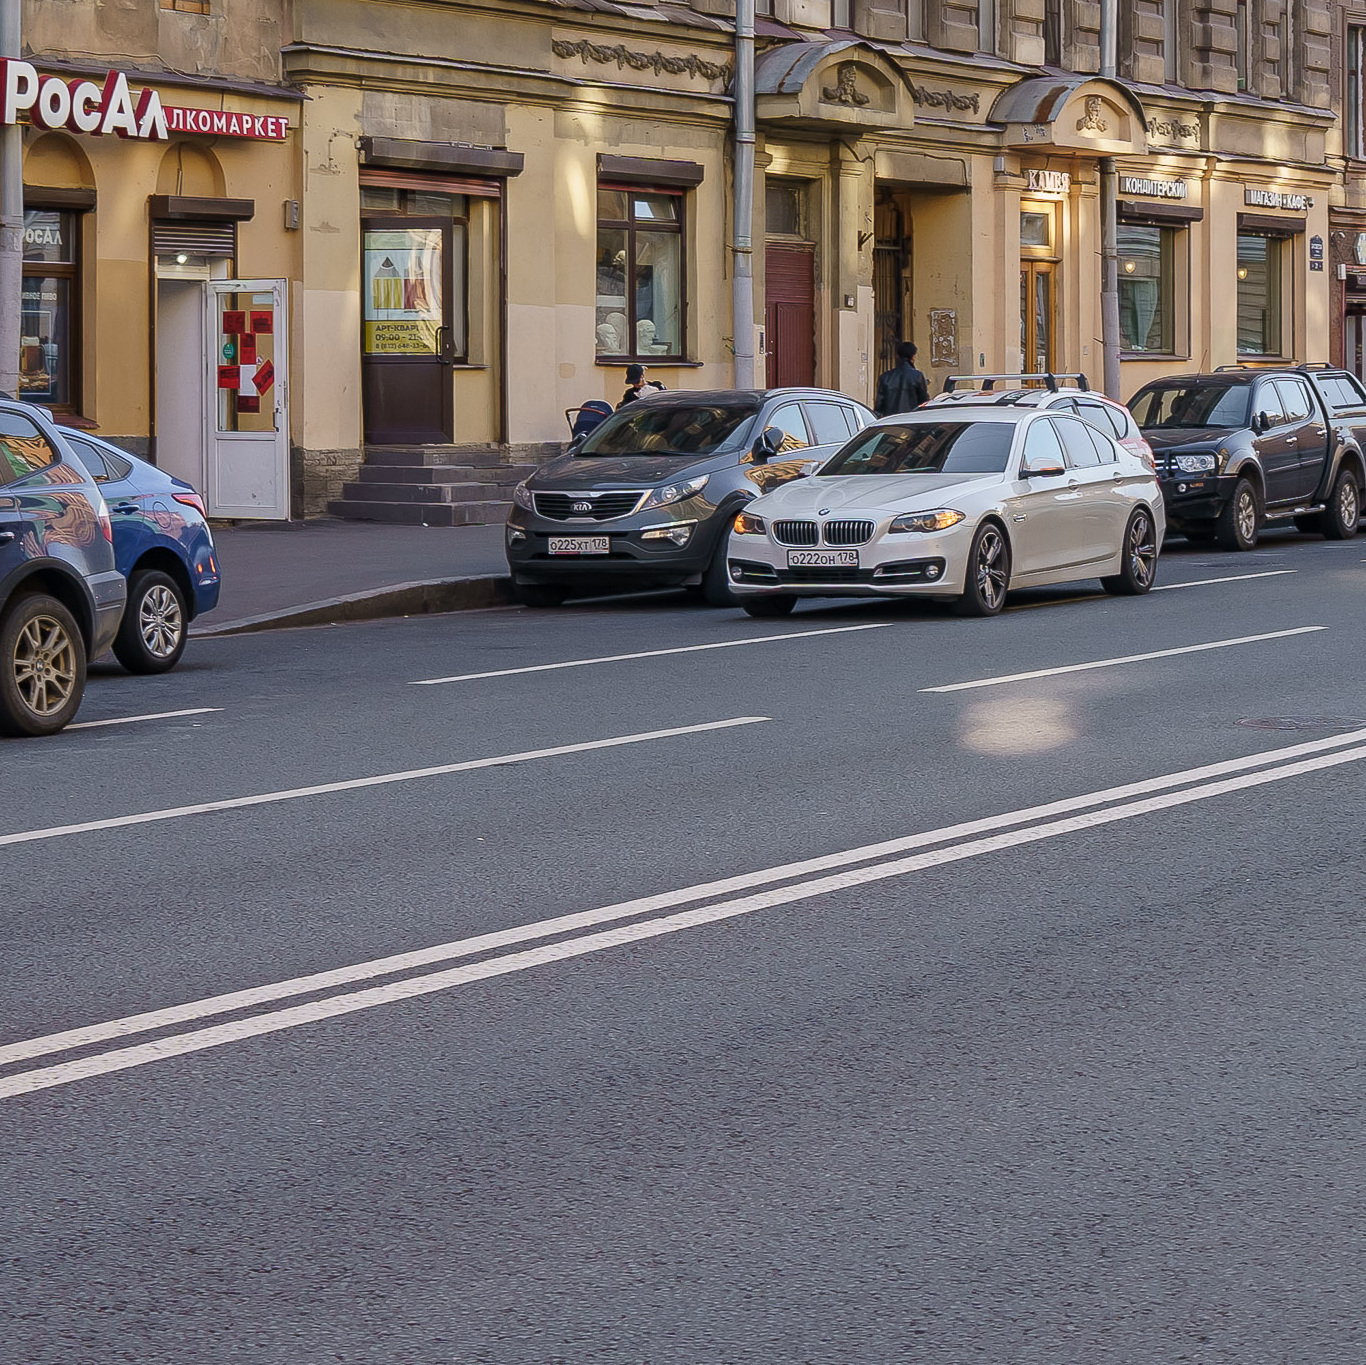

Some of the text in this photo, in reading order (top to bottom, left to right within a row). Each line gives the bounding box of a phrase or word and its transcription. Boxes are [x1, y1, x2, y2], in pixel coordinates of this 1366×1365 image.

[1028, 170, 1070, 193] КАМЕЯ
[1125, 177, 1188, 198] КОНДИТЕРСКИЙ
[573, 503, 588, 511] KIA
[550, 538, 607, 551] О225ХТ 178
[791, 552, 854, 565] О222ОН 178
